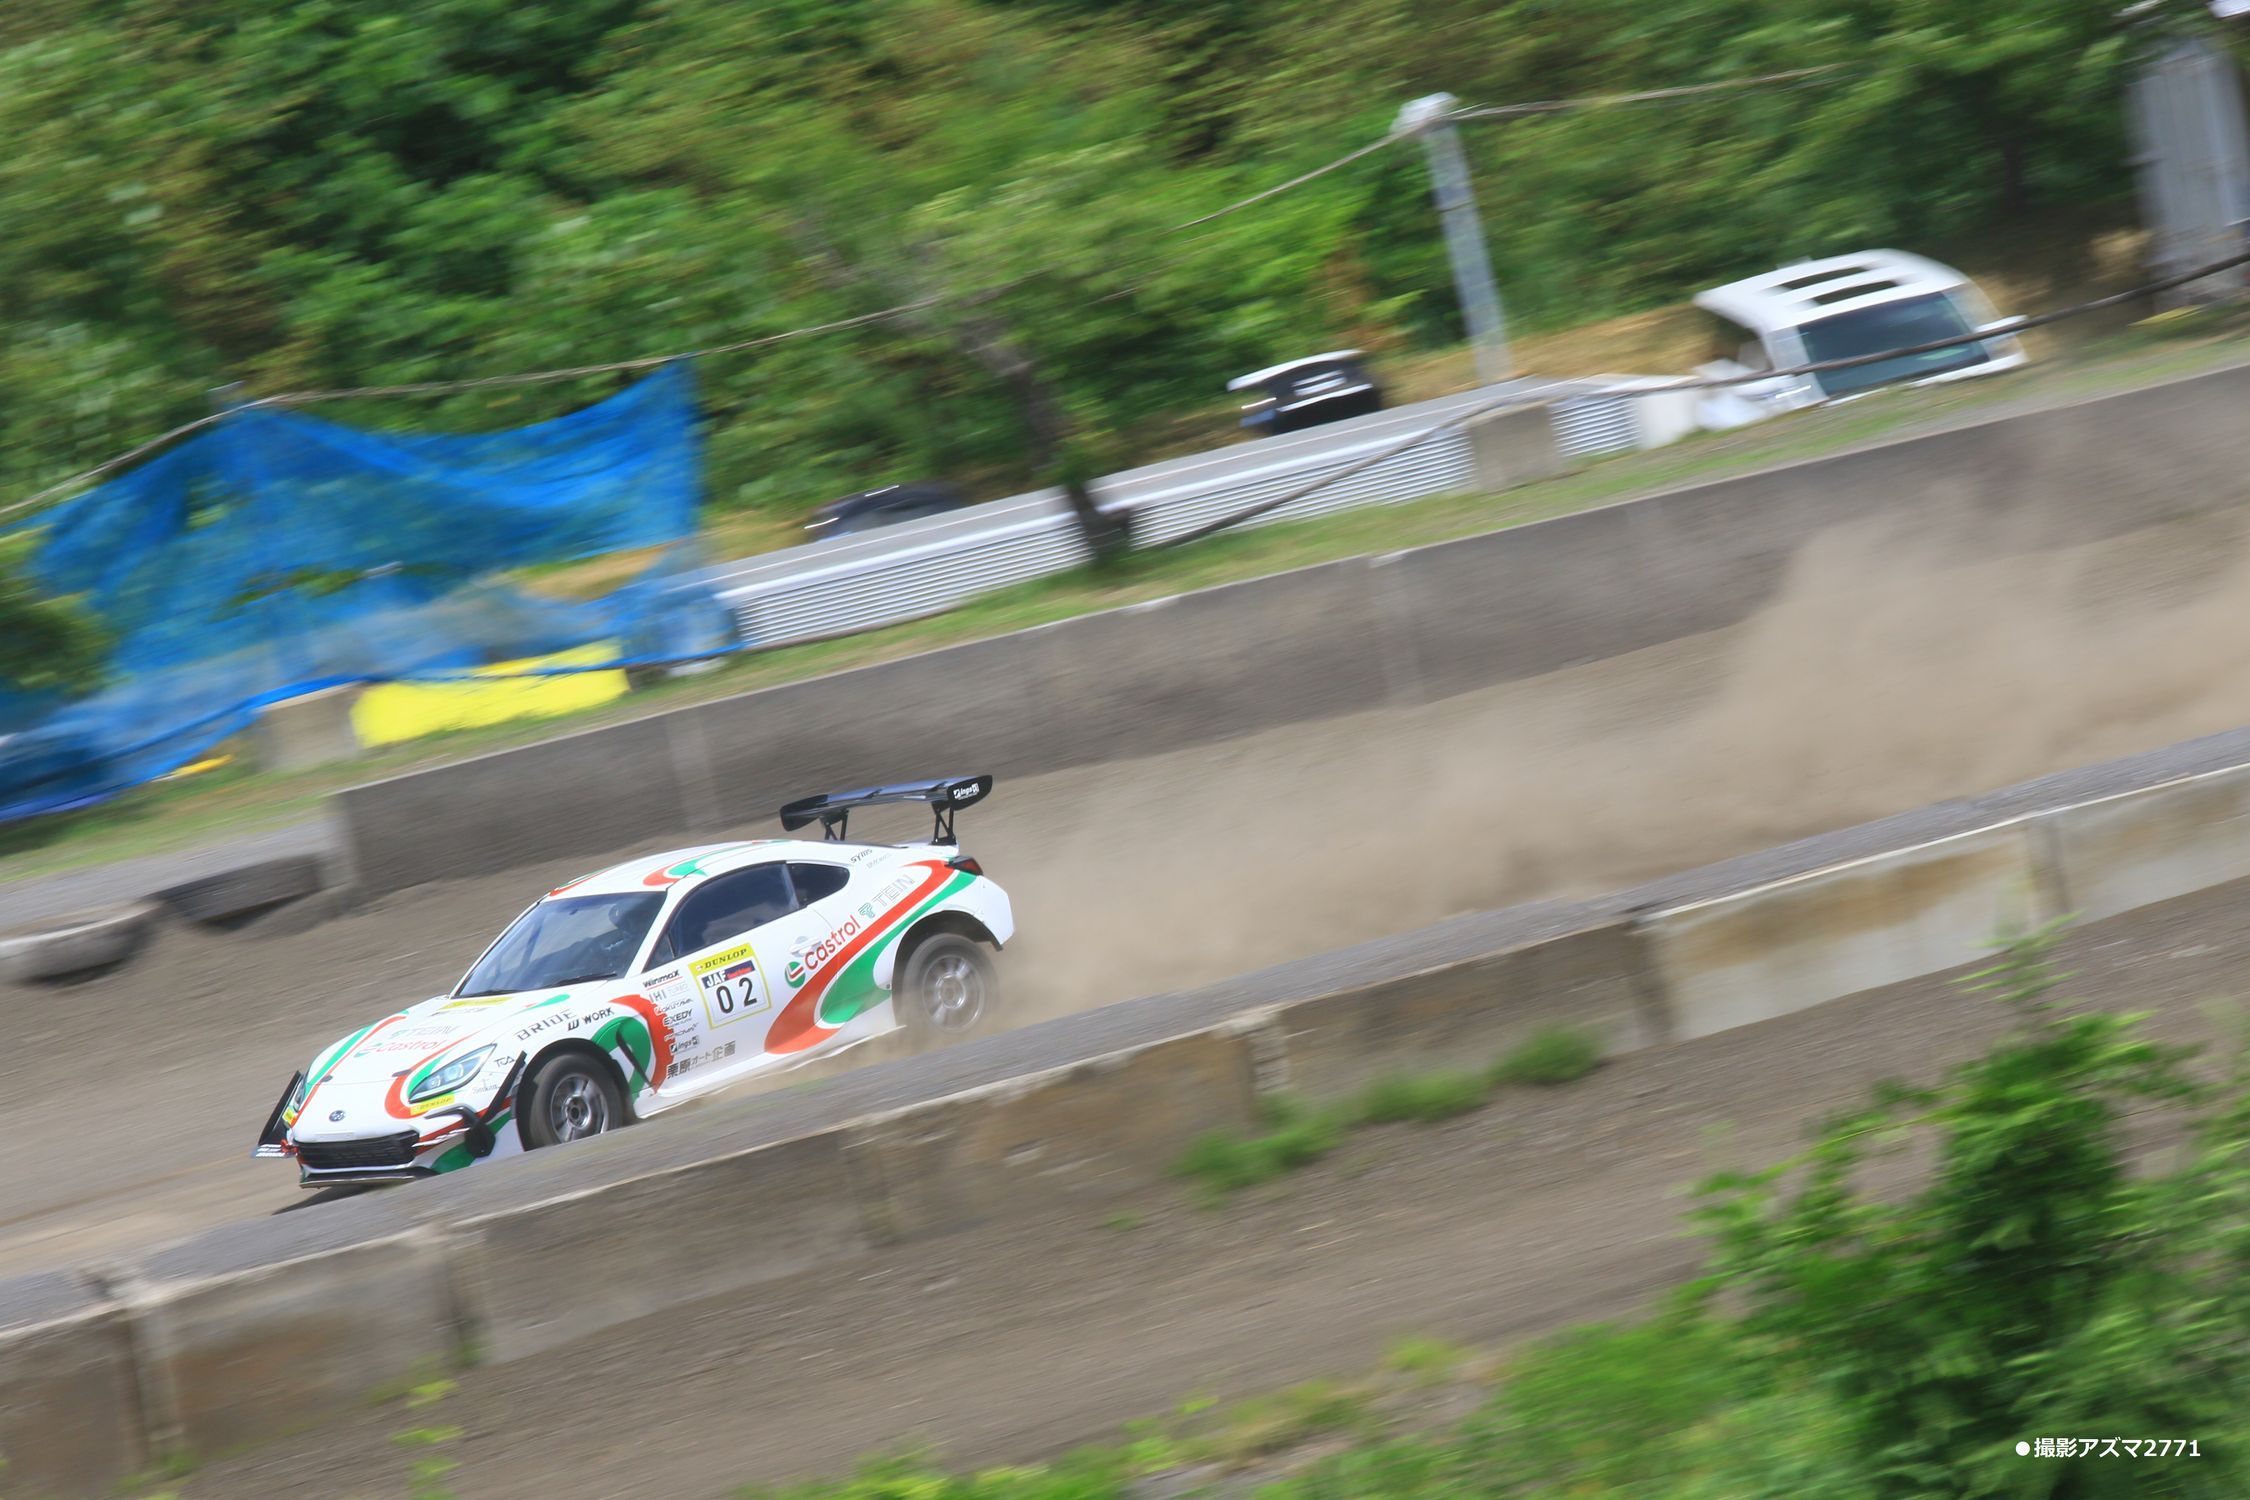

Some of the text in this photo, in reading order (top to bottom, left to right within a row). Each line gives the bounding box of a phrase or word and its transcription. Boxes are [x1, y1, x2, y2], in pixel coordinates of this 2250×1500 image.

[873, 874, 916, 907] TEIN
[705, 948, 748, 969] DUNLOP
[707, 971, 729, 988] JAF
[716, 977, 758, 1014] 02
[515, 1009, 578, 1041] BRIDE
[583, 1007, 615, 1025] WORK
[664, 1009, 693, 1025] EXEDY
